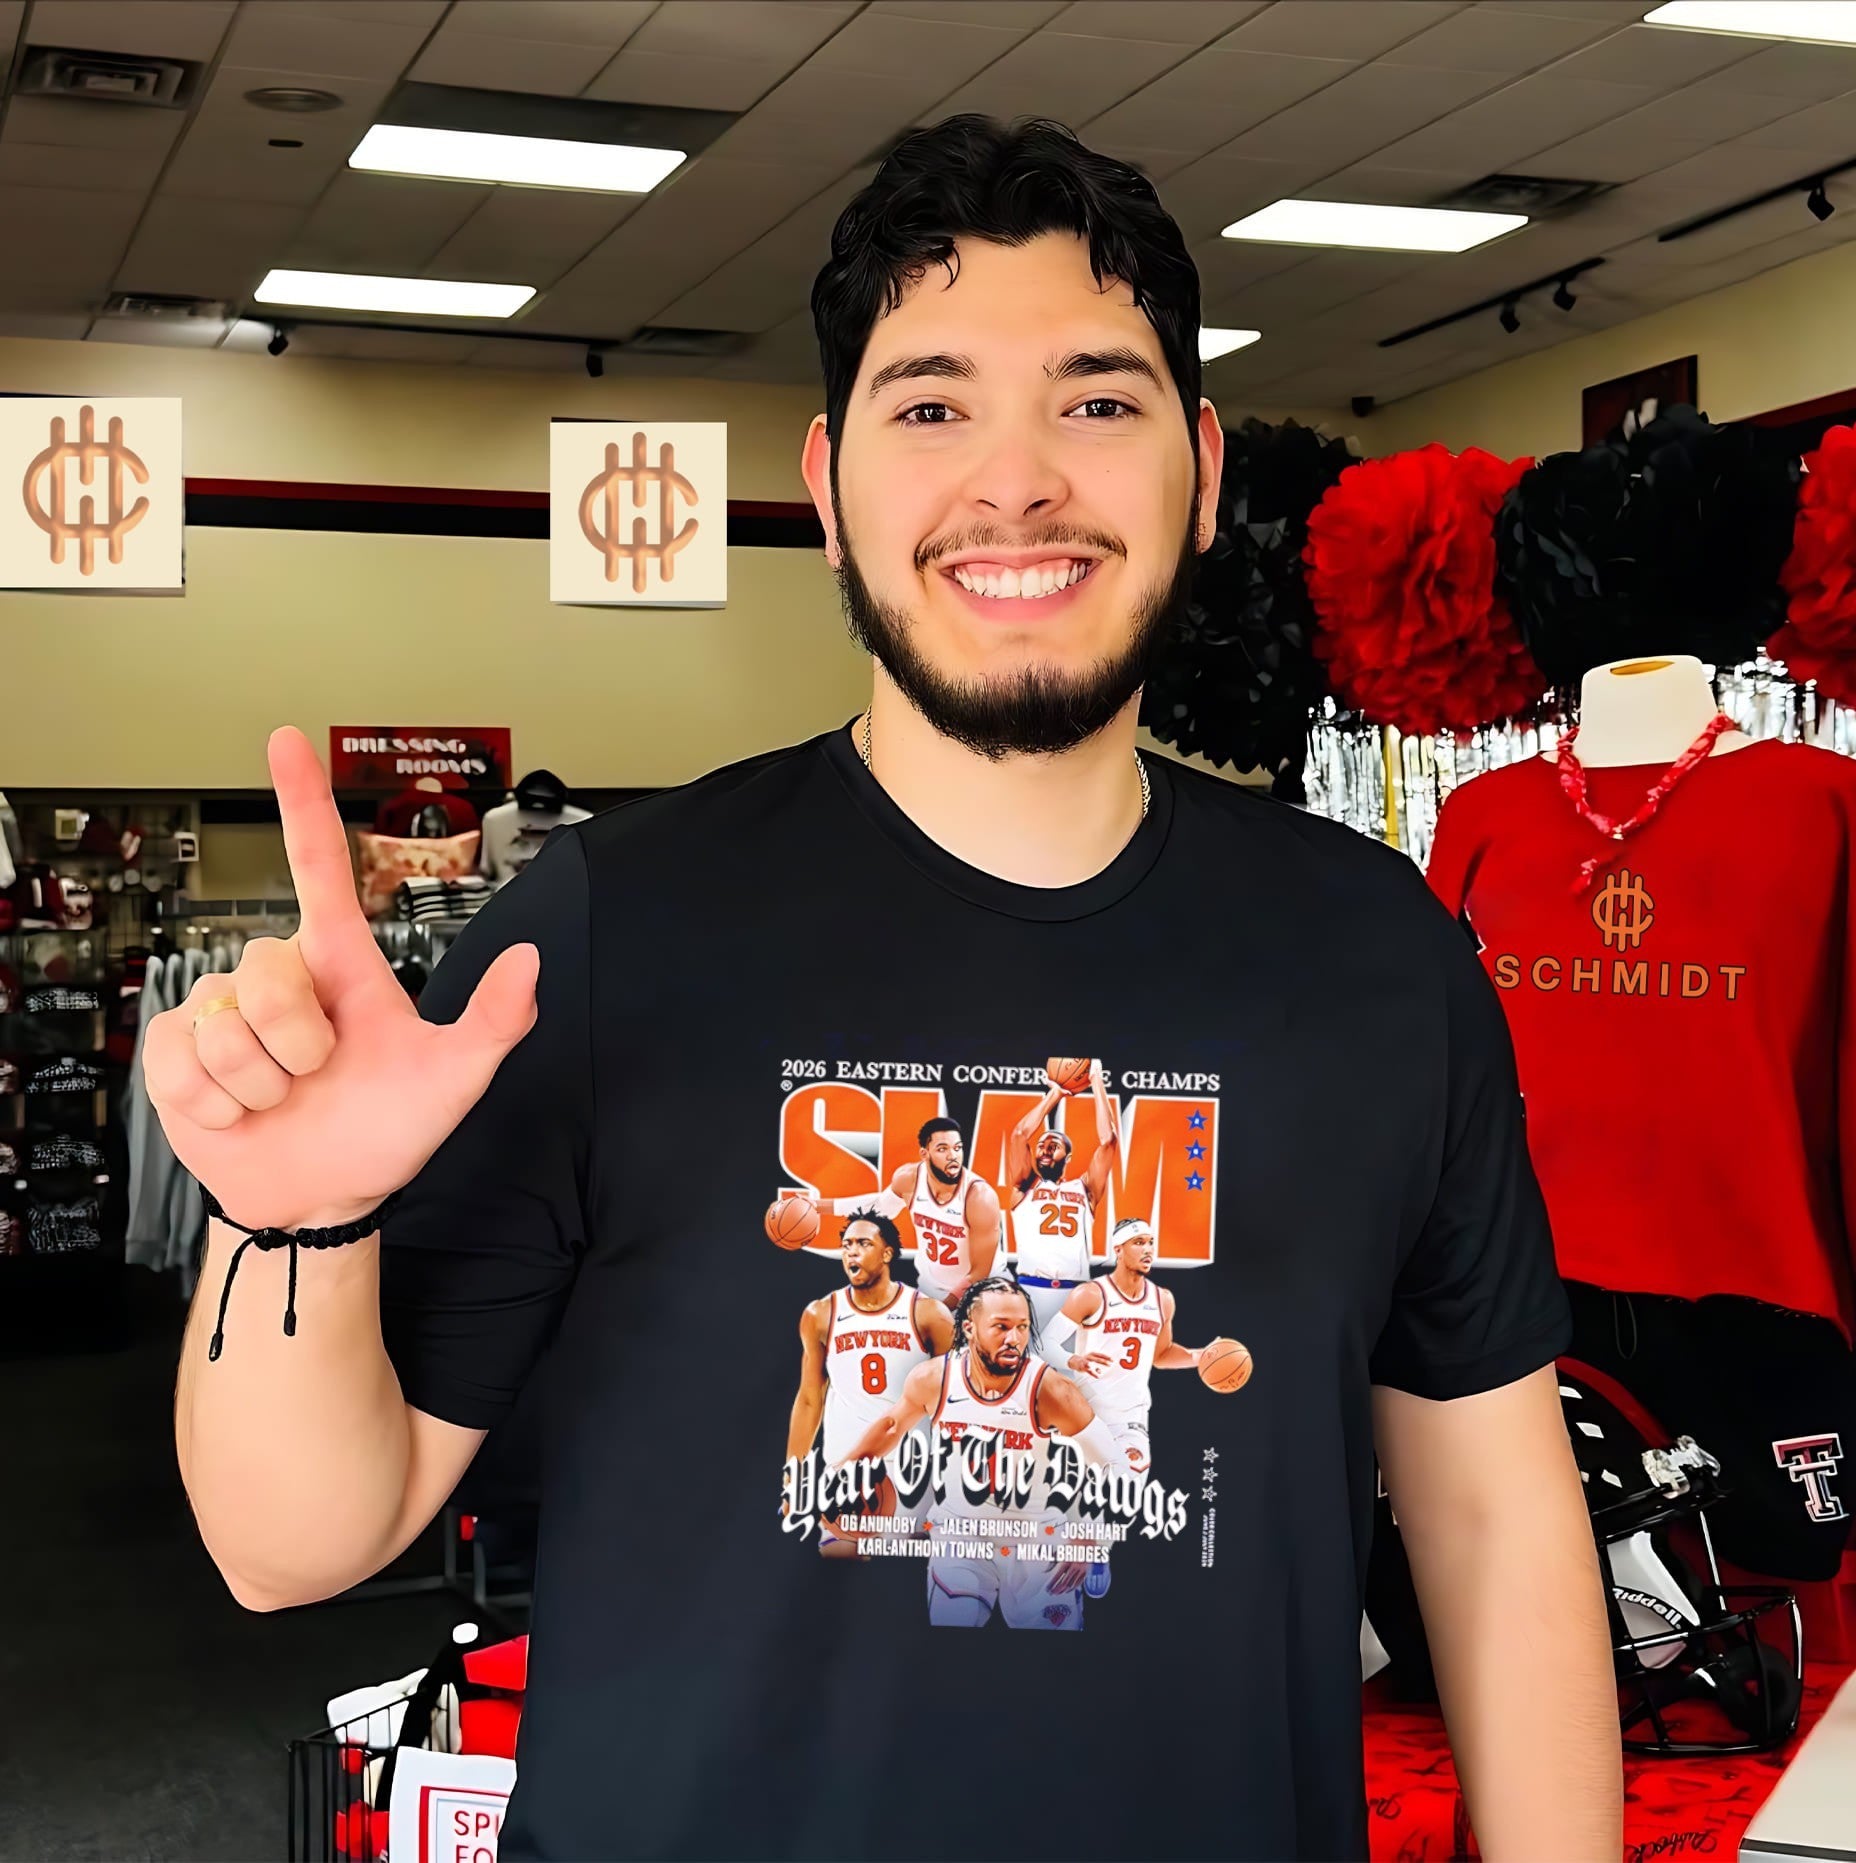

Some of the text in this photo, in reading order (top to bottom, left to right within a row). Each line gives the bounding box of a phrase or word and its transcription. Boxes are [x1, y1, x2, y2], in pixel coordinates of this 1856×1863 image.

[1495, 954, 1746, 1000] SCHMIDT
[781, 1059, 826, 1078] 2026
[836, 1061, 943, 1082] EASTERN
[952, 1065, 1112, 1088] CONFERE
[1121, 1071, 1220, 1091] CHAMPS
[777, 1081, 1221, 1268] SLAM
[1039, 1203, 1079, 1238] 25
[922, 1231, 959, 1266] 32
[834, 1329, 911, 1355] NEW YORK
[1119, 1336, 1142, 1371] 3
[861, 1353, 888, 1395] 8
[781, 1424, 1190, 1542] Year Of The Dawgs
[840, 1513, 1128, 1542] OG ANUNOBY JALEN BRUNSON JOSH HART
[857, 1537, 1110, 1564] KARL-ANTHONY TOWNS MIKAL BRIDGES
